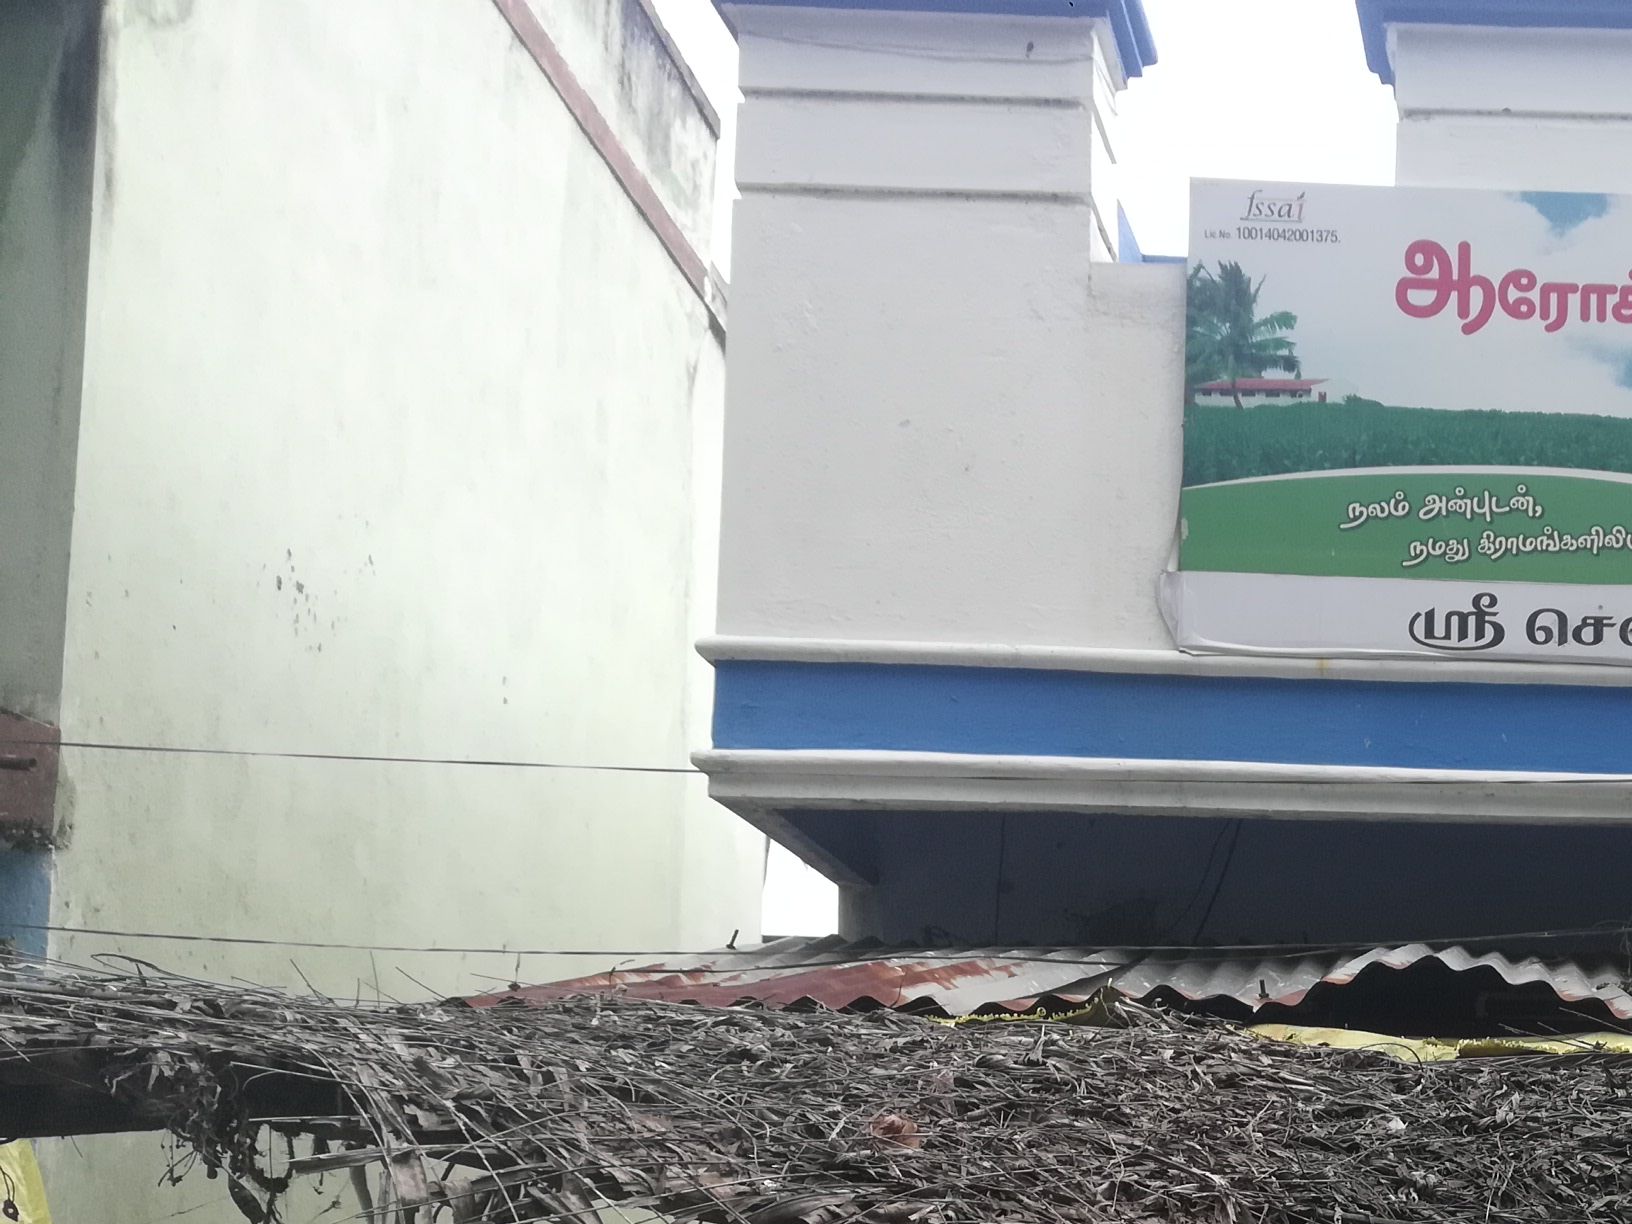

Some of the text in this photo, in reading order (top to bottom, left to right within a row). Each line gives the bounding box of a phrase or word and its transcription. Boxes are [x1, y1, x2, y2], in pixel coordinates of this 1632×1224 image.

[1338, 483, 1545, 528] நலம் அன்புடன்,
[1401, 536, 1470, 567] நமது
